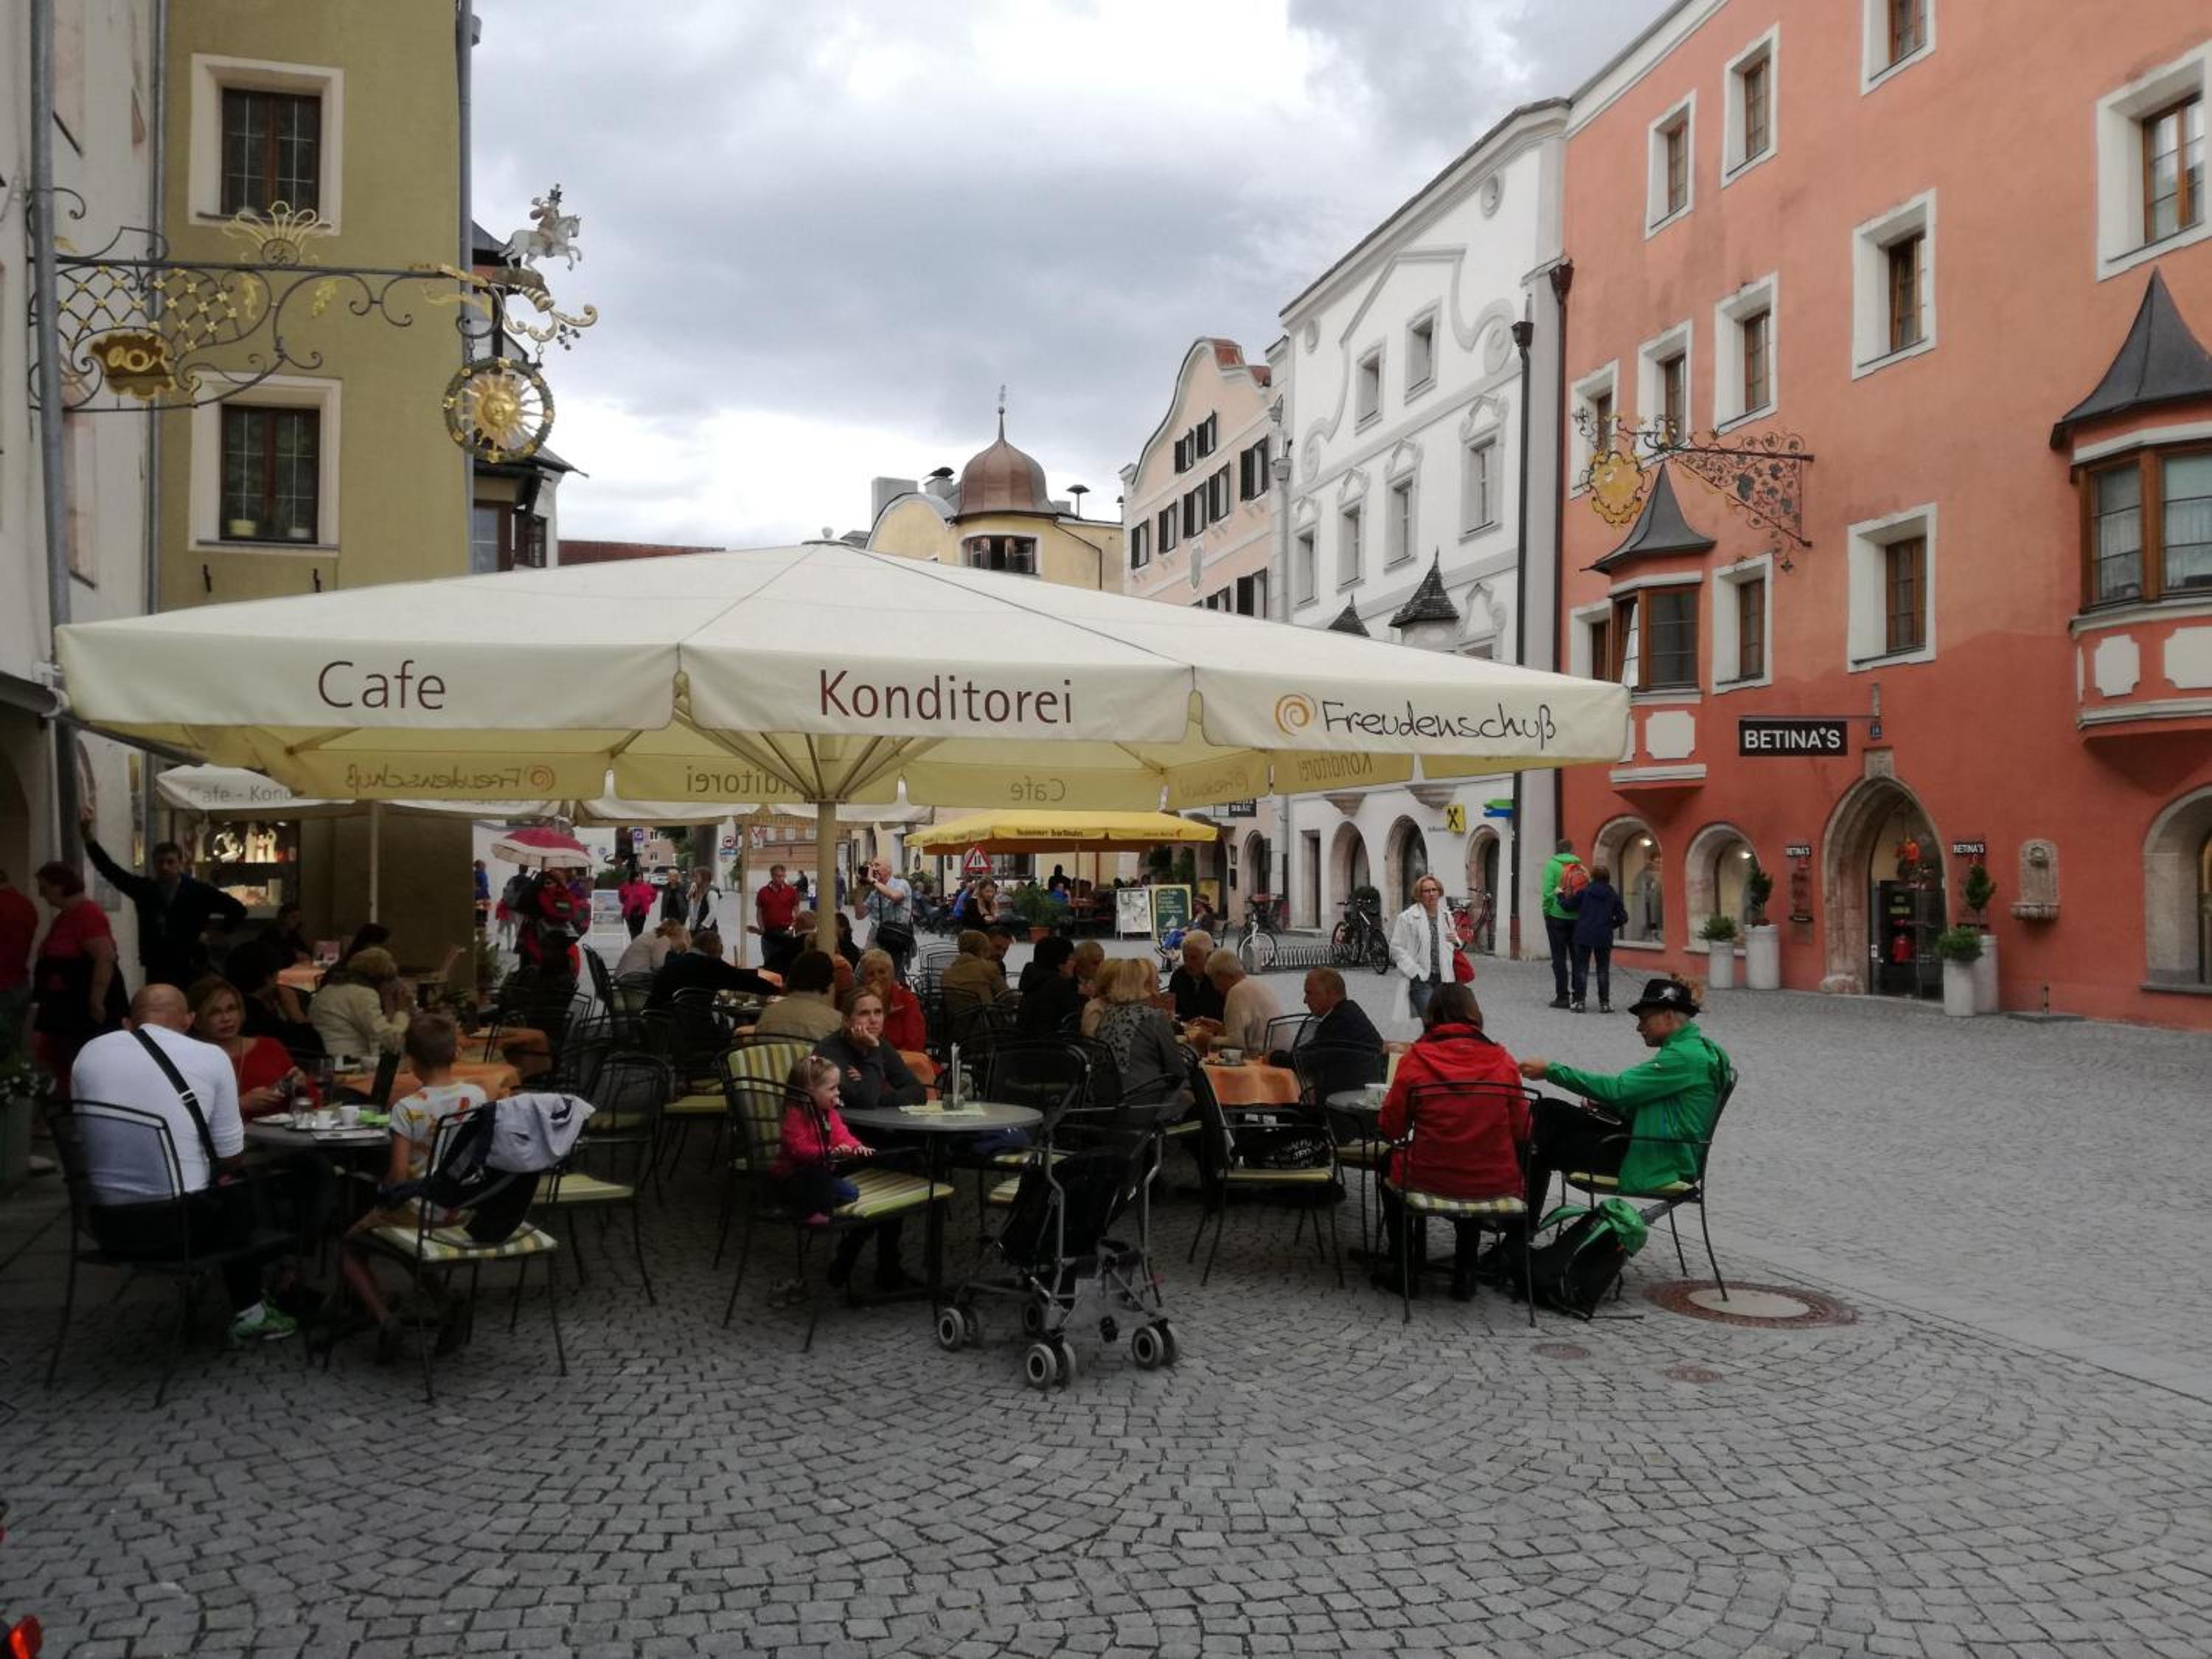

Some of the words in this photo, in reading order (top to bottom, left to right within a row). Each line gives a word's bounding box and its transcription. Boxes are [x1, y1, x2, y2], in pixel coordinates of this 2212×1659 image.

[318, 659, 445, 710] Cafe
[820, 669, 1071, 723] Konditorei
[1322, 700, 1557, 751] Freudenschuß
